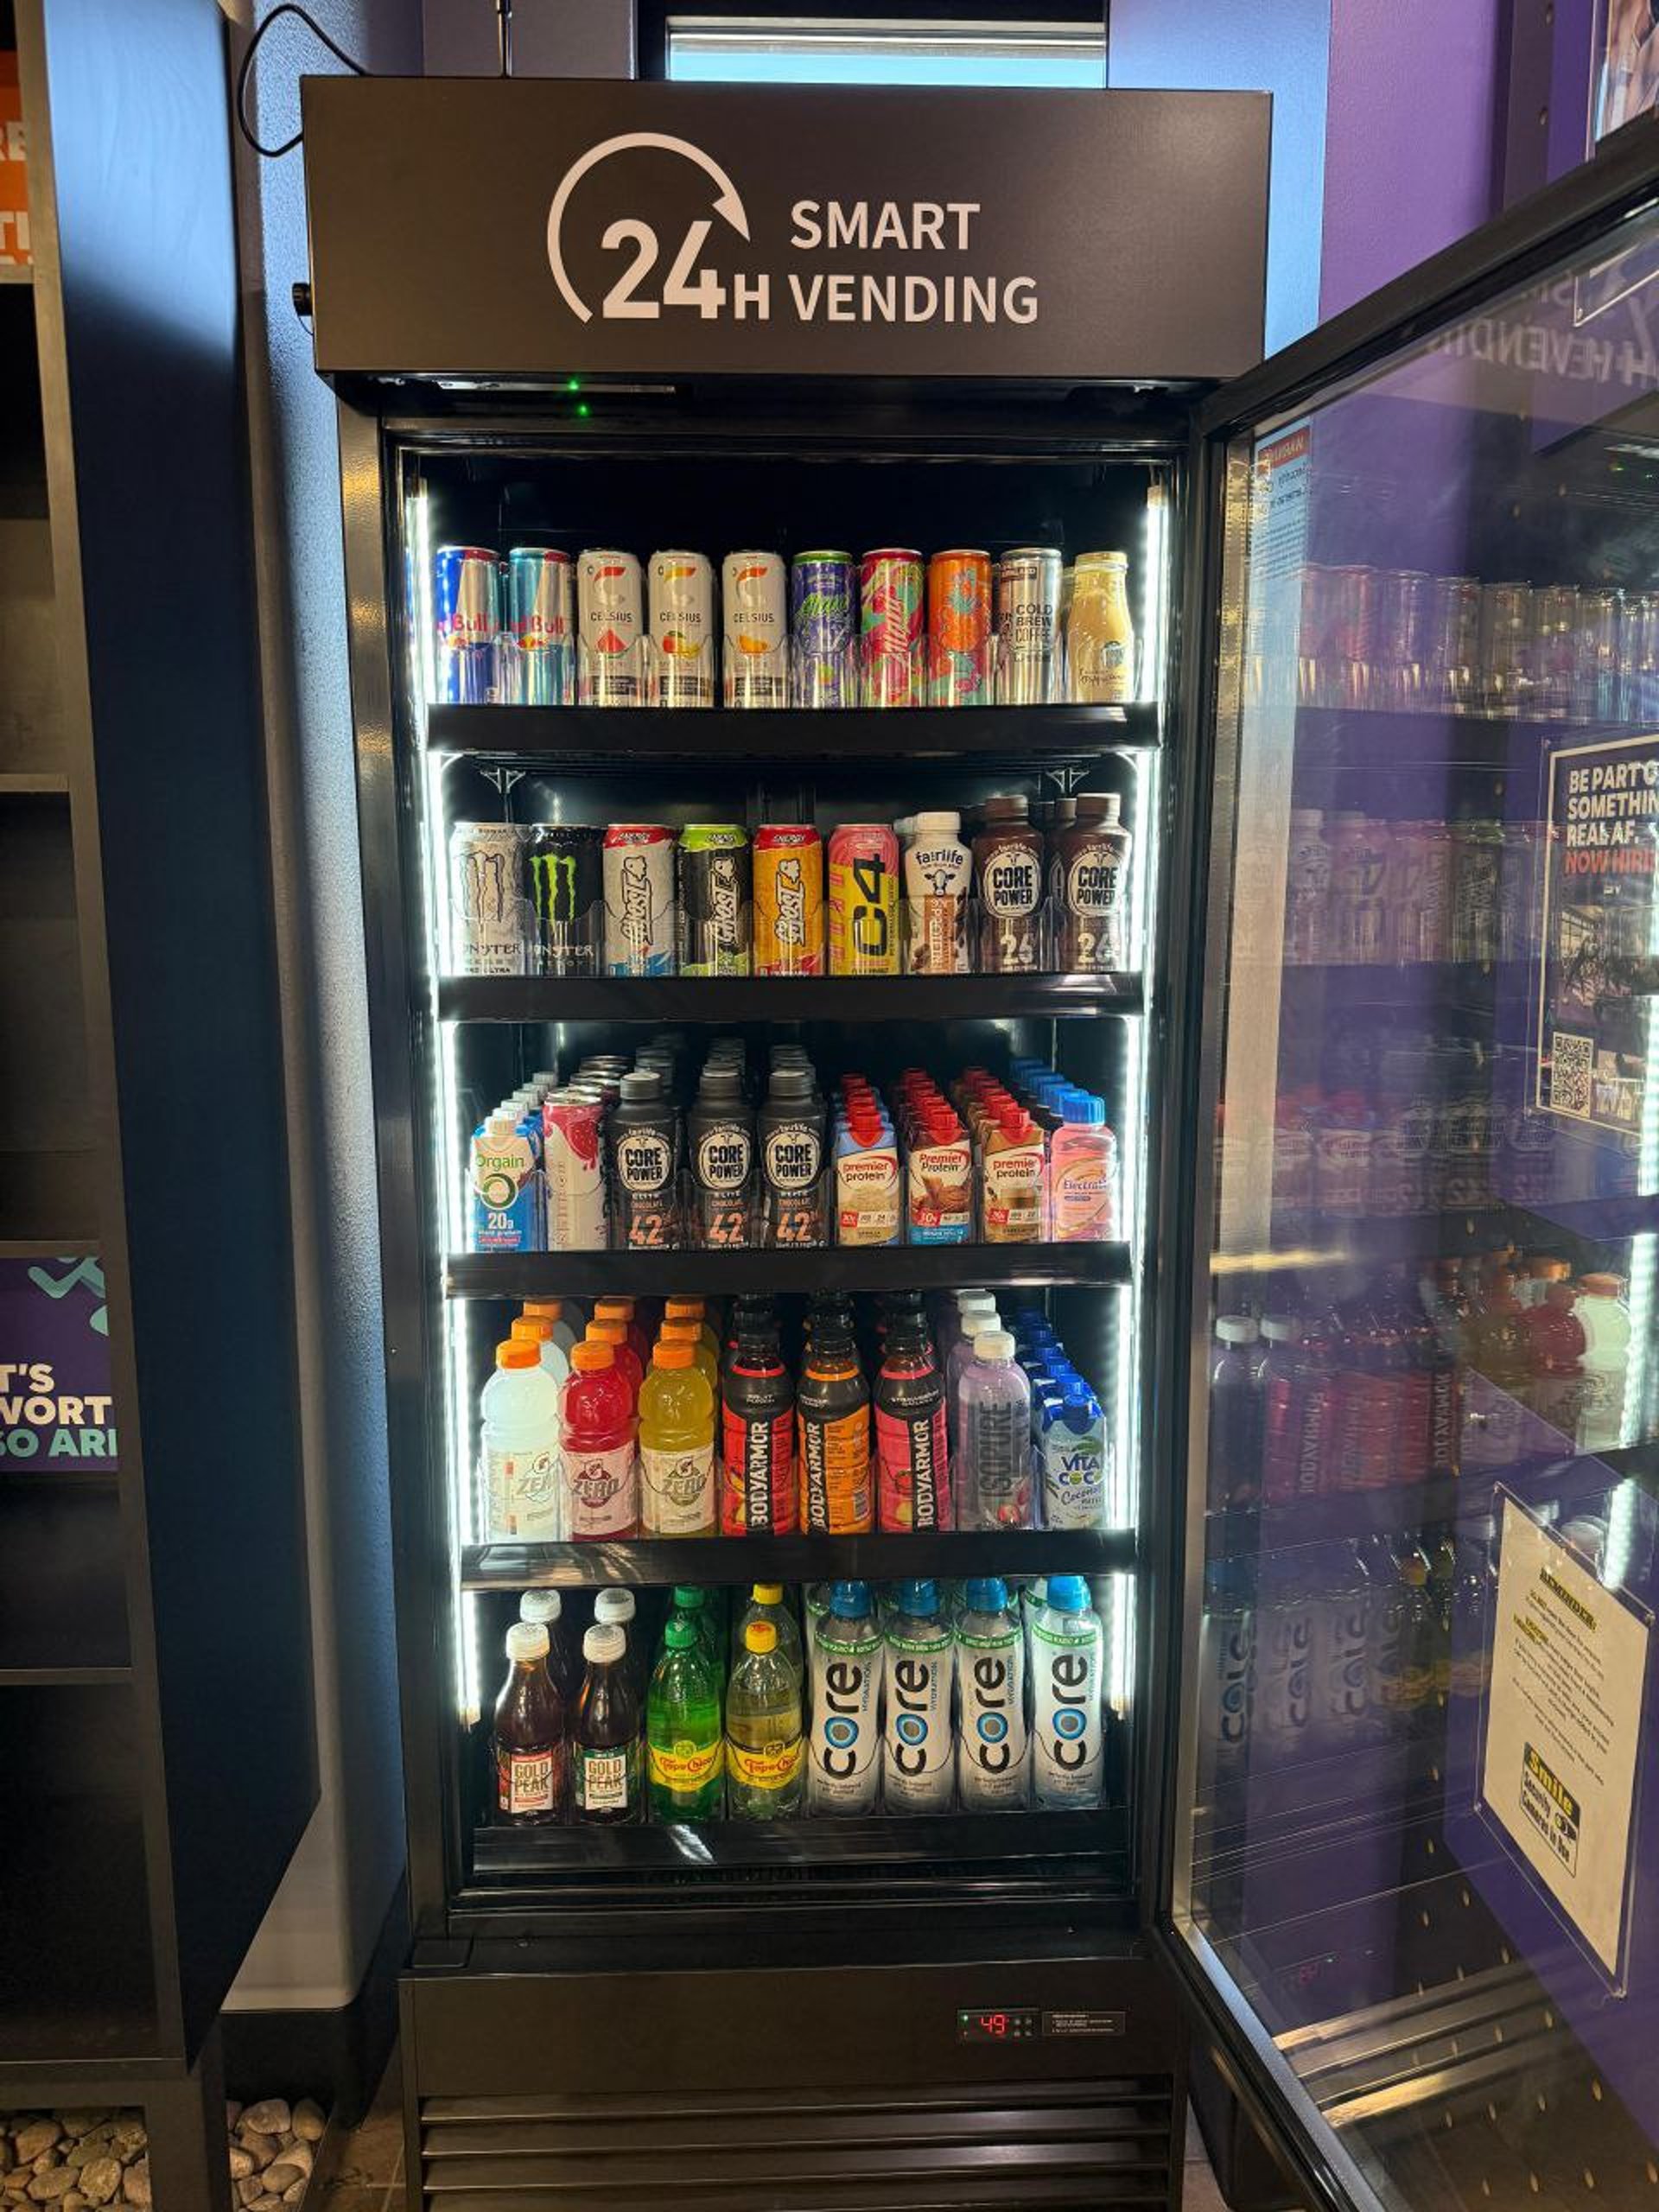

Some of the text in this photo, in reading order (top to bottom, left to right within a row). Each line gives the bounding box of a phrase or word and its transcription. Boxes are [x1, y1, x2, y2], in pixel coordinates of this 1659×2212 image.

[790, 200, 981, 251] SMART
[601, 218, 1039, 325] 24H VENDING
[590, 611, 633, 623] CELSIUS
[659, 611, 702, 623] CELSIUS
[734, 612, 775, 624] CELSIUS
[1015, 604, 1052, 616] COLD
[1015, 616, 1052, 627] BREW
[1015, 628, 1052, 644] COFFEE
[1568, 770, 1590, 793] BE
[1592, 763, 1641, 791] PART
[1567, 821, 1610, 848] REAL
[915, 849, 964, 866] fairlife
[994, 865, 1033, 888] CORE
[1077, 865, 1116, 888] CORE
[853, 853, 887, 957] C4
[994, 888, 1033, 906] POWER
[1077, 888, 1116, 906] POWER
[476, 1154, 524, 1173] Orgain
[625, 1147, 663, 1166] CORE
[709, 1144, 744, 1164] CORE
[775, 1143, 812, 1164] CORE
[626, 1166, 663, 1180] POWER
[709, 1164, 744, 1179] POWER
[776, 1164, 812, 1178] POWER
[842, 1160, 888, 1174] premier
[846, 1170, 886, 1183] protein
[996, 1167, 1036, 1180] protein
[629, 1214, 664, 1245] 42
[709, 1212, 745, 1244] 42
[776, 1212, 811, 1243] 42
[978, 1401, 1013, 1497] ISOPURE
[1061, 1453, 1100, 1471] VITA
[749, 1421, 768, 1528] BODYARMOR
[806, 1421, 827, 1529] BODYARMOR
[913, 1419, 934, 1528] BODYARMOR
[572, 1478, 620, 1497] ZERO
[663, 1474, 707, 1496] ZERO
[823, 1662, 862, 1780] core
[895, 1660, 930, 1777] core
[974, 1656, 1009, 1774] core
[1052, 1654, 1088, 1771] core
[514, 1759, 549, 1779] GOLD
[588, 1758, 622, 1776] GOLD
[514, 1774, 550, 1793] PEAK
[588, 1772, 623, 1792] PEAK
[1529, 1748, 1573, 1817] Smile
[981, 2014, 1006, 2034] 49
